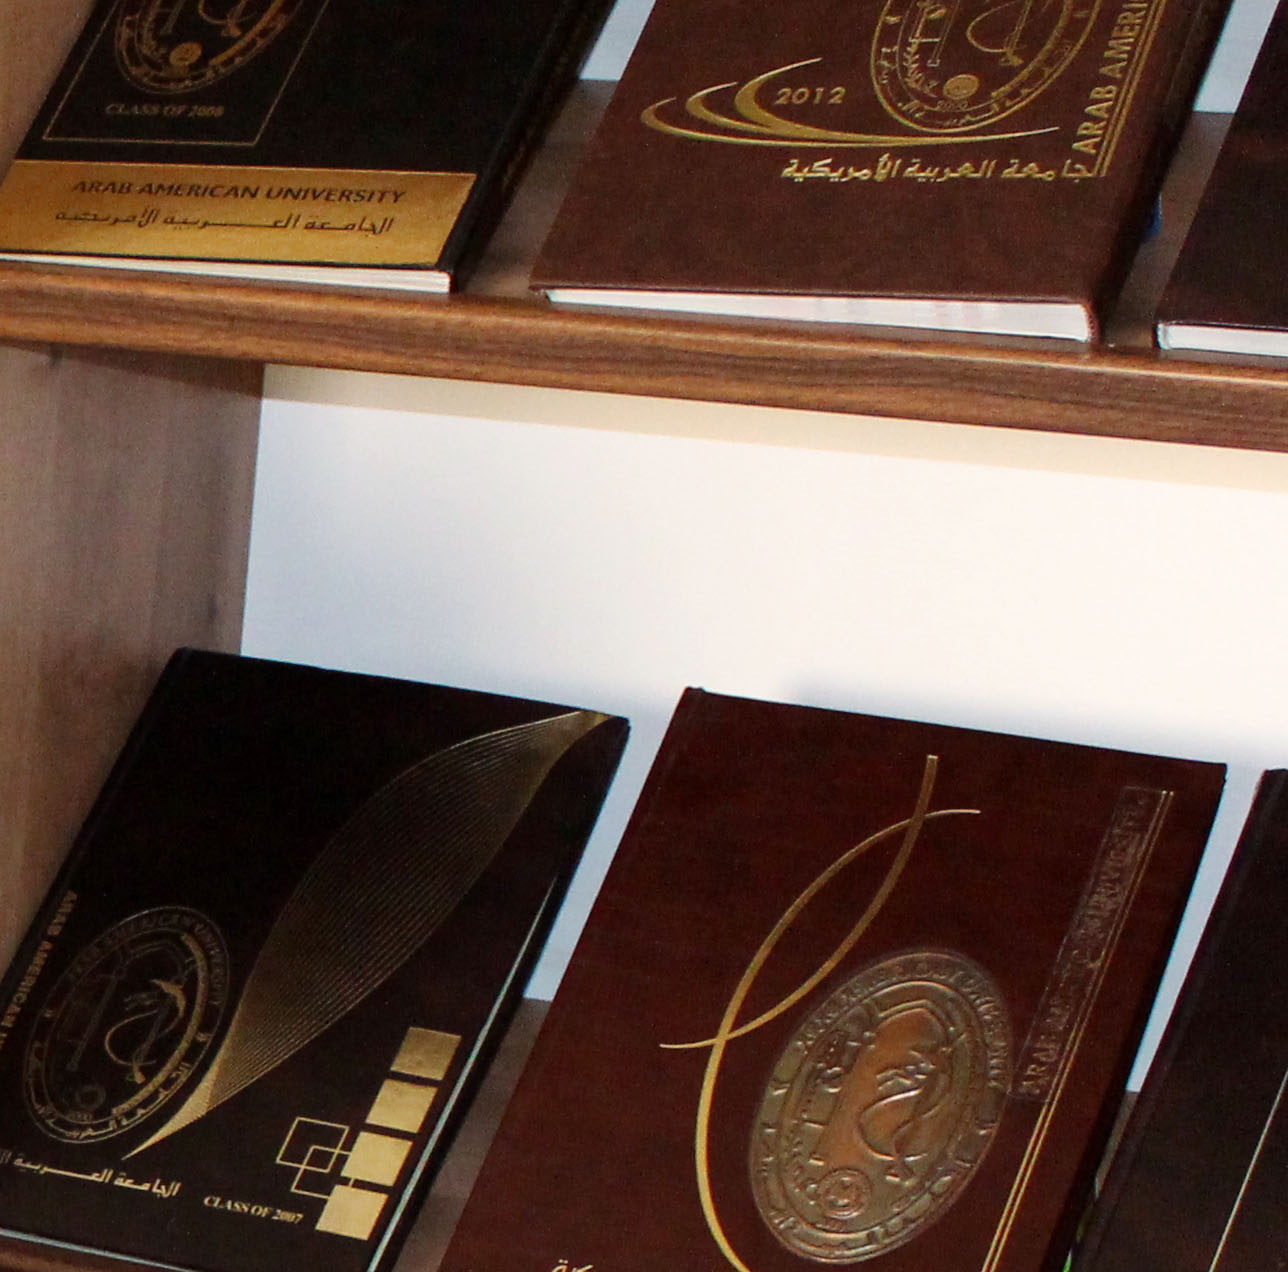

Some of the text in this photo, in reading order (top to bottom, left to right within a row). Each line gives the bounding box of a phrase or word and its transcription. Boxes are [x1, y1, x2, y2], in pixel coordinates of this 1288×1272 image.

[1072, 0, 1149, 155] ARAB AMERI
[775, 87, 846, 105] 2012
[903, 157, 997, 182] العربية
[74, 181, 407, 204] ARAB AMERICAN UNIVERSITY
[12, 1152, 113, 1185] العربية
[113, 1170, 182, 1199] الجامعة
[203, 1195, 304, 1225] CLASS OF 2007
